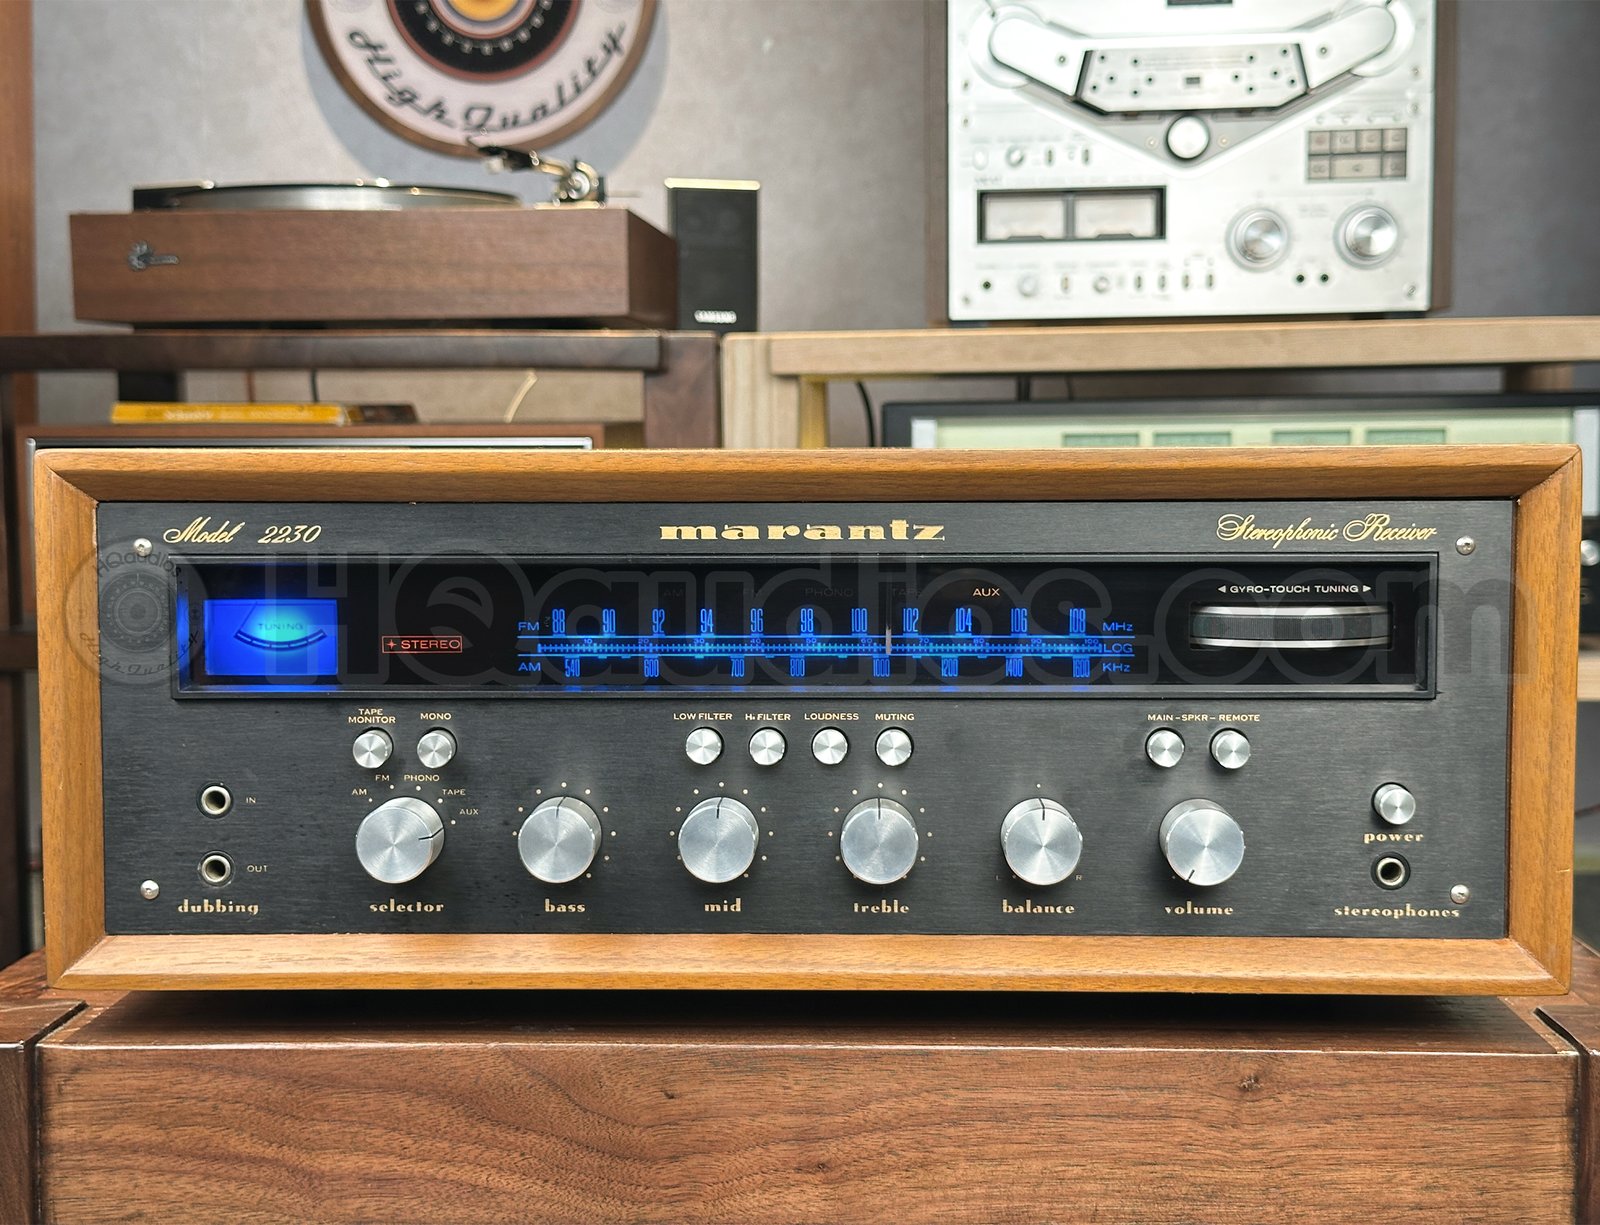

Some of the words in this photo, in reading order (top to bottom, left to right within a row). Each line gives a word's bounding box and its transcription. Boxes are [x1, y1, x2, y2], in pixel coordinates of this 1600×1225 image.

[349, 31, 456, 129] High
[463, 25, 627, 132] Quality
[163, 516, 245, 544] Model
[257, 525, 322, 544] 2230
[660, 519, 946, 541] marantz
[1216, 513, 1338, 550] Stereophonic
[1343, 513, 1437, 543] Receiver
[972, 587, 1001, 597] AUX
[1229, 584, 1311, 594] GYRO-TOUCH
[1314, 584, 1359, 594] TUNING
[518, 622, 540, 631] FM
[552, 608, 566, 633] 88
[602, 608, 616, 633] 90
[652, 608, 666, 633] 92
[700, 608, 714, 633] 94
[750, 608, 764, 633] 96
[800, 608, 814, 633] 98
[851, 608, 868, 633] 100
[903, 608, 919, 633] 102
[955, 608, 972, 633] 104
[1010, 608, 1028, 633] 106
[1069, 608, 1086, 633] 108
[1102, 622, 1133, 632] MHz
[258, 622, 304, 631] TUNING
[401, 640, 460, 650] STEREO
[1102, 643, 1133, 653] LOG
[518, 663, 541, 671] AM
[564, 658, 581, 677] 540
[644, 658, 660, 677] 600
[730, 658, 745, 677] 700
[789, 658, 806, 677] 800
[873, 658, 890, 677] 1000
[941, 658, 959, 677] 1200
[1005, 658, 1023, 677] 1400
[1072, 658, 1091, 678] 1600
[1102, 663, 1131, 672] KHz
[358, 708, 383, 716] TAPE
[420, 712, 452, 720] MONO
[673, 712, 696, 720] LOW
[698, 712, 733, 720] FILTER
[757, 713, 791, 721] FILTER
[804, 712, 859, 720] LOUDNESS
[875, 712, 915, 721] MUTING
[1147, 713, 1174, 721] MAIN
[1218, 713, 1260, 721] REMOTE
[348, 716, 396, 724] MONITOR
[375, 774, 390, 782] FM
[404, 774, 440, 782] PHONO
[352, 788, 367, 796] AM
[442, 788, 466, 796] TAPE
[459, 808, 479, 816] AUX
[1363, 831, 1424, 844] power
[247, 864, 267, 873] OUT
[177, 899, 260, 915] dubbing
[369, 899, 444, 913] selector
[545, 899, 586, 913] bass
[704, 898, 742, 912] mid
[853, 899, 910, 914] treble
[1002, 899, 1076, 914] balance
[1164, 901, 1234, 915] volume
[1334, 904, 1461, 918] stereophones
